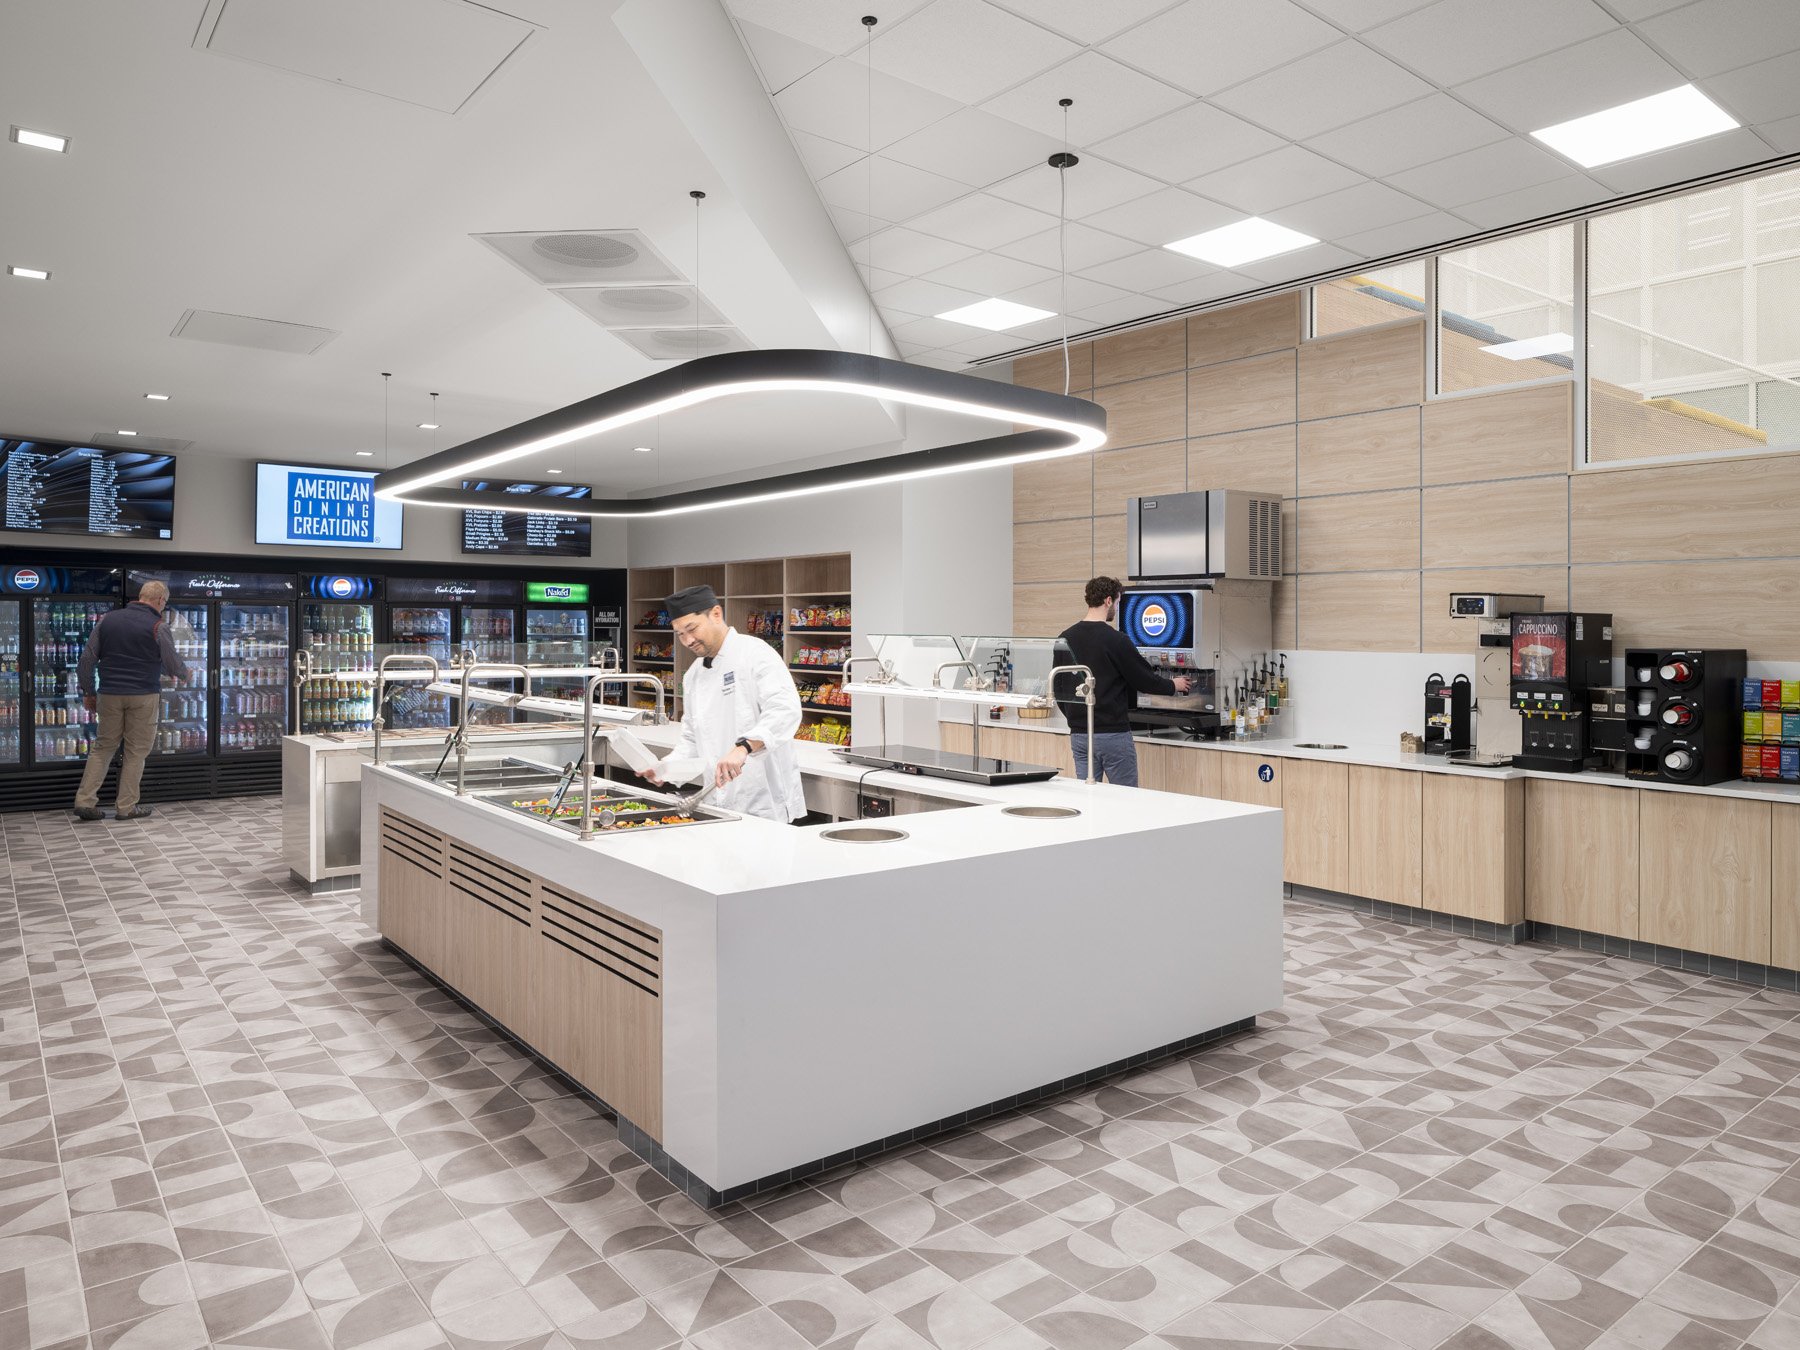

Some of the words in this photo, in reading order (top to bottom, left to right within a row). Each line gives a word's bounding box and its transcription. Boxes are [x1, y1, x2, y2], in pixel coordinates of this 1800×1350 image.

[294, 478, 370, 502] AMERICAN
[293, 500, 369, 518] DINING
[293, 516, 369, 538] CREATIONS
[188, 579, 206, 589] Fresh
[206, 579, 241, 589] Difference
[435, 585, 449, 595] Fresh
[449, 585, 477, 595] Difference
[547, 587, 569, 597] Naked
[1143, 616, 1166, 624] PEPSI
[553, 786, 564, 800] A
